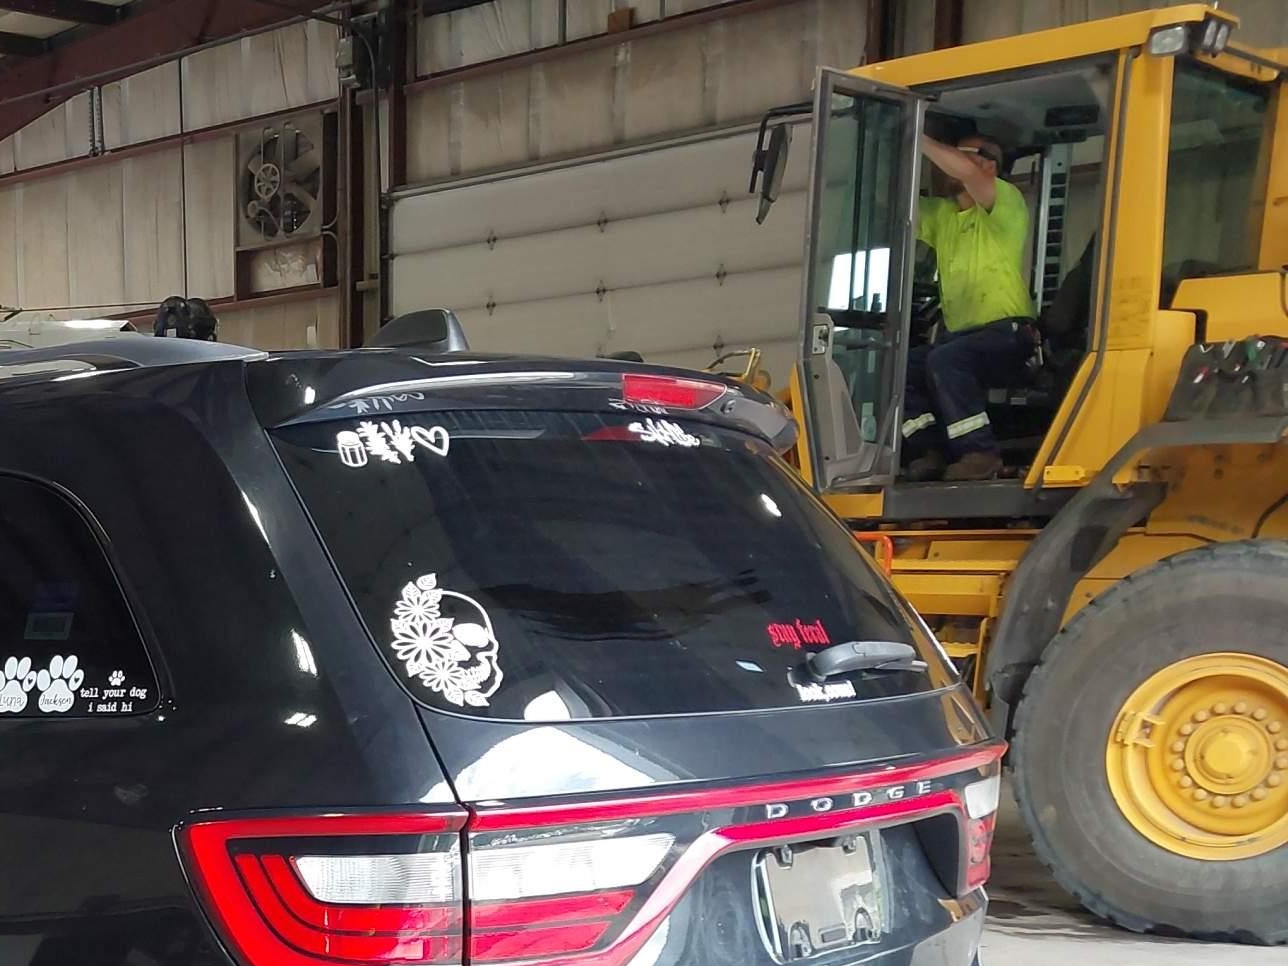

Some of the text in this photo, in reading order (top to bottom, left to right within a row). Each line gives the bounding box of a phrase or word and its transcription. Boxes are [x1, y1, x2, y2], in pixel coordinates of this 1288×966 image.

[80, 686, 148, 700] tell your dog
[96, 701, 118, 712] said
[120, 701, 133, 712] hi
[766, 780, 932, 820] DODGE
